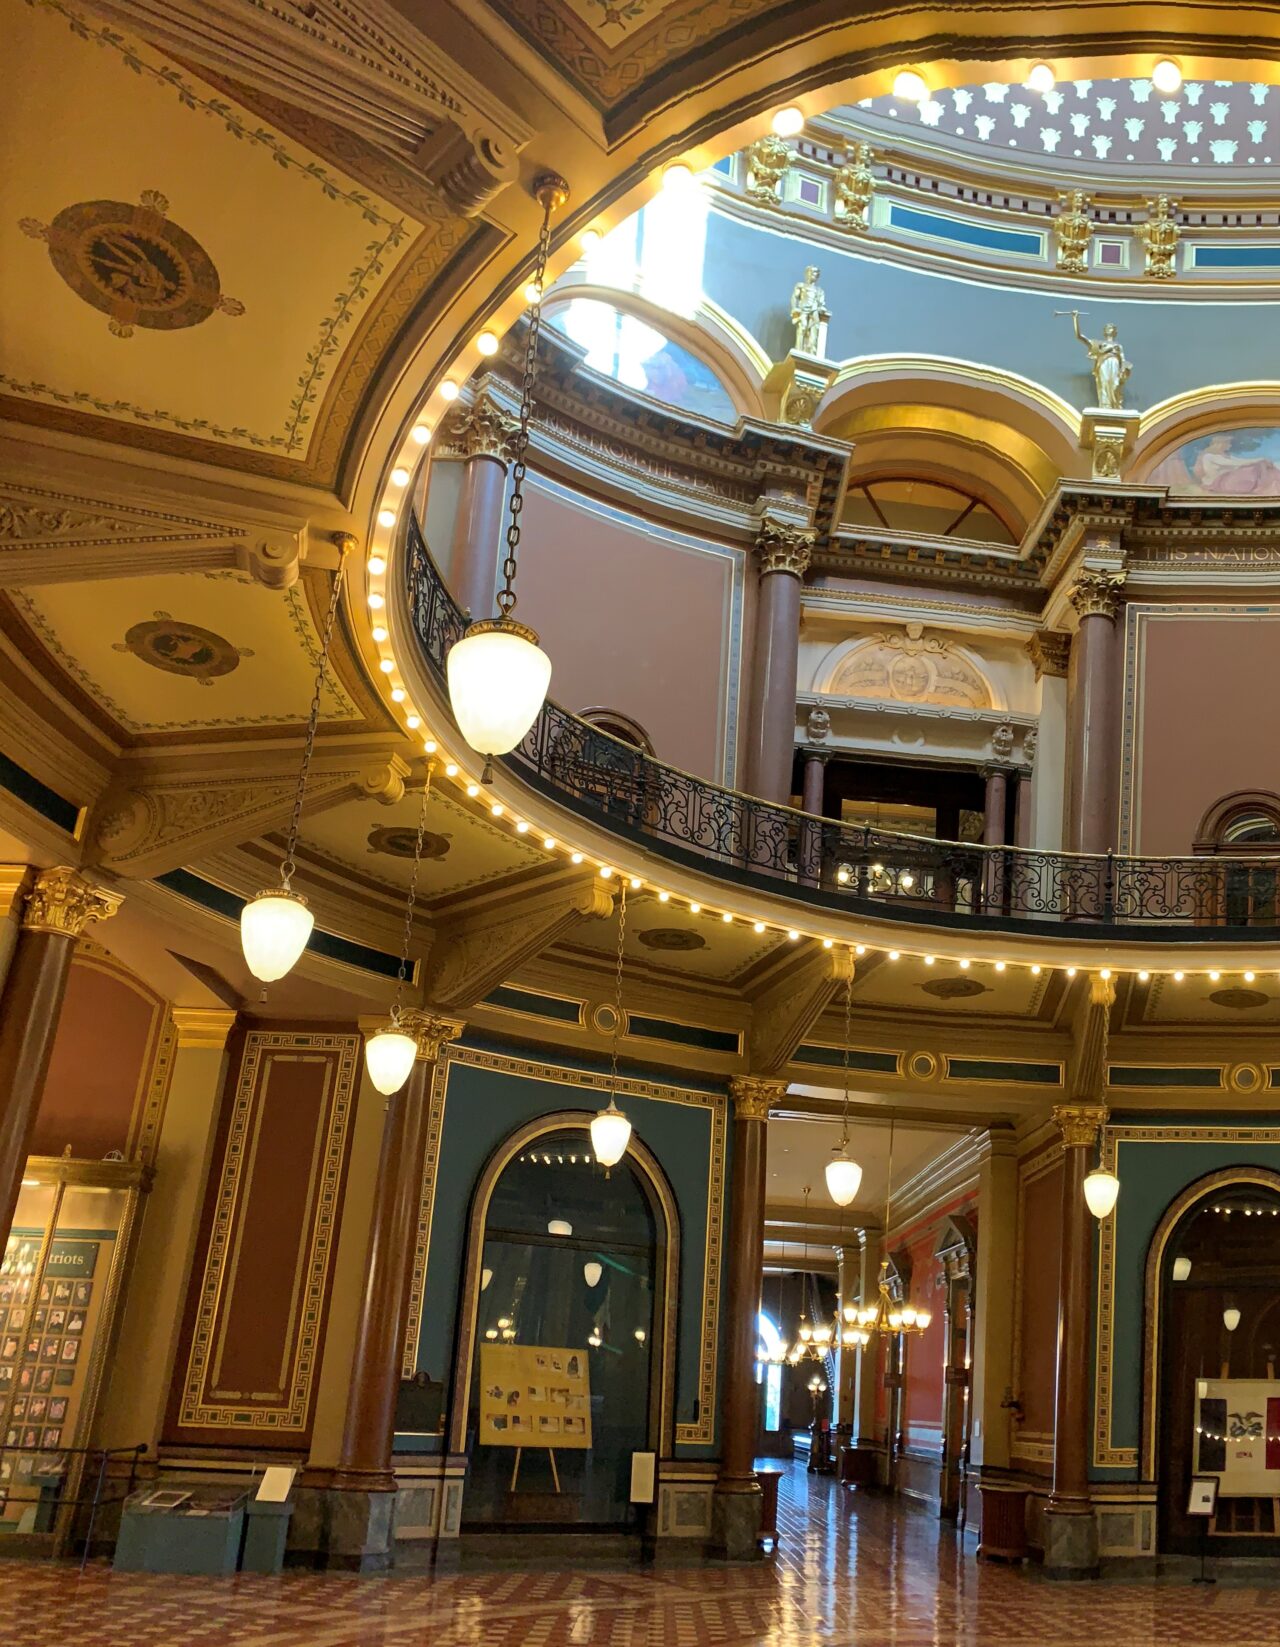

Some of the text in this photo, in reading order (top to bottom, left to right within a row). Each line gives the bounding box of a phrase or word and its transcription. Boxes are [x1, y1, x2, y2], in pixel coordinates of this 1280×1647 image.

[590, 430, 639, 466] FROM
[646, 458, 679, 480] THE
[692, 473, 745, 501] EARTH
[1144, 546, 1188, 561] THIS
[32, 1249, 84, 1265] Ptriots
